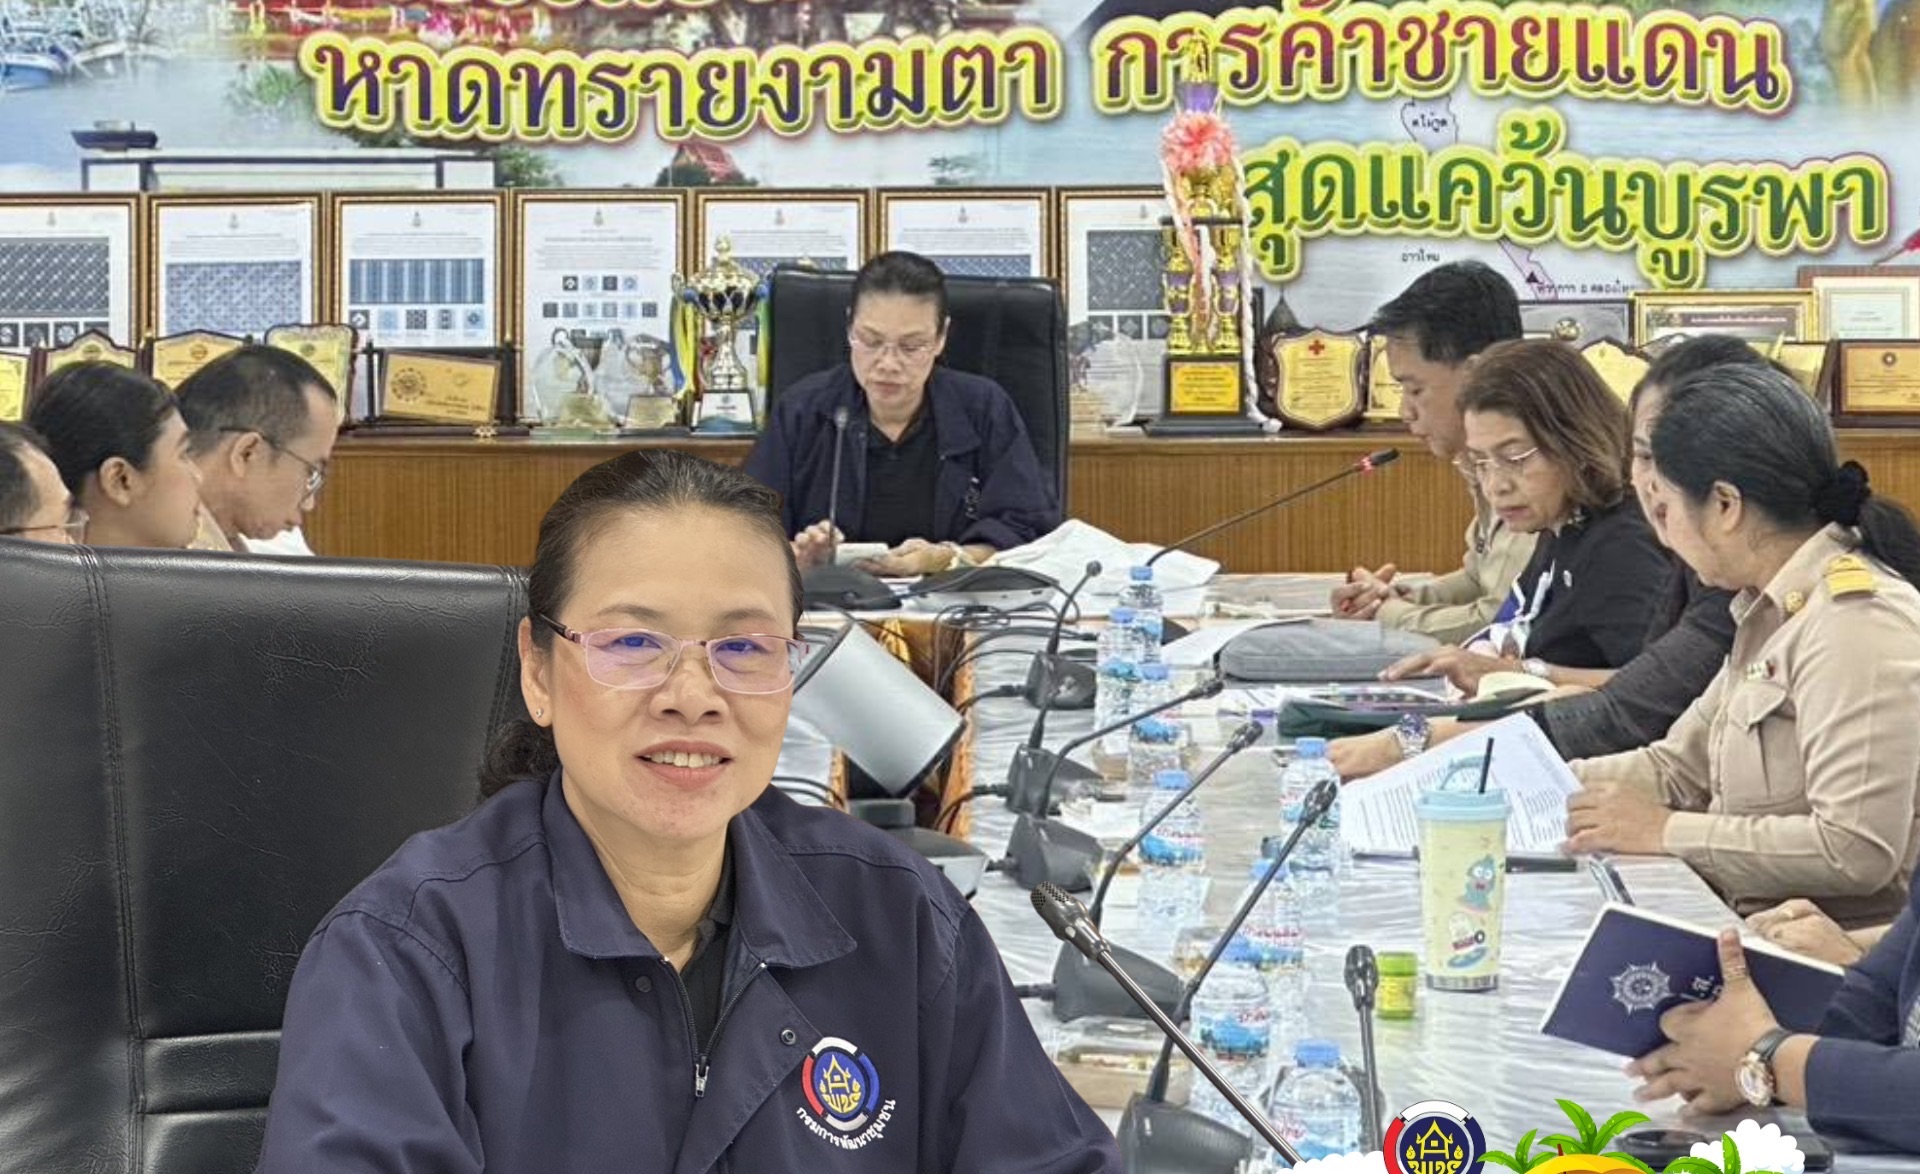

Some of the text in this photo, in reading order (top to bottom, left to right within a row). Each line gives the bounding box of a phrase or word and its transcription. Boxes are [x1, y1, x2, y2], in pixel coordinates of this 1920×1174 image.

[312, 39, 1050, 130] หาดทรายงามตา
[1243, 119, 1877, 283] สุดแคว้นบูรพา
[796, 1099, 897, 1150] กรมการพัฒนาชุมชน
